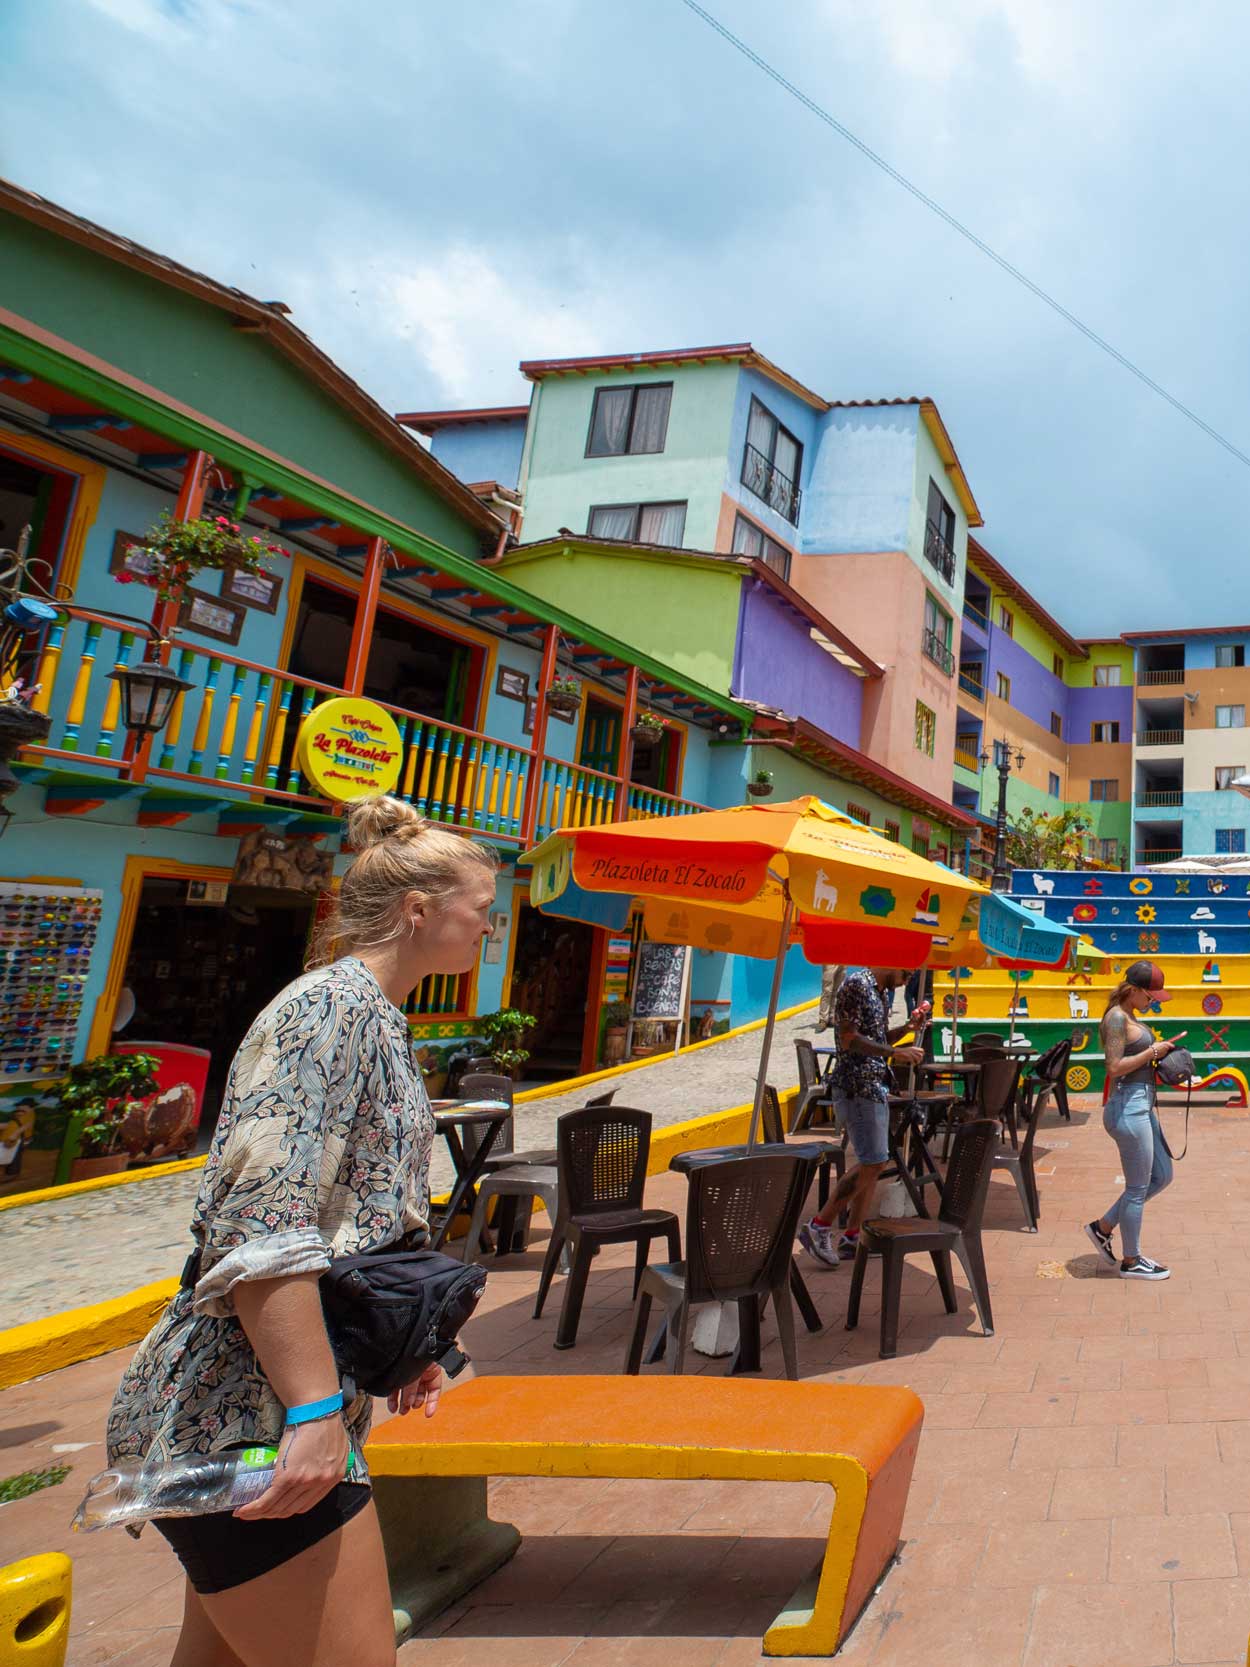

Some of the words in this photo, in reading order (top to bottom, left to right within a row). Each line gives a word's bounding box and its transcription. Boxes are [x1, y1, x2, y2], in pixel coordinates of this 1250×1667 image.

[313, 733, 331, 752] La
[336, 737, 399, 764] Plazoleta
[590, 857, 669, 884] Plazoleta
[673, 863, 695, 886] El
[692, 867, 747, 892] Zocalo
[654, 948, 671, 959] LAS
